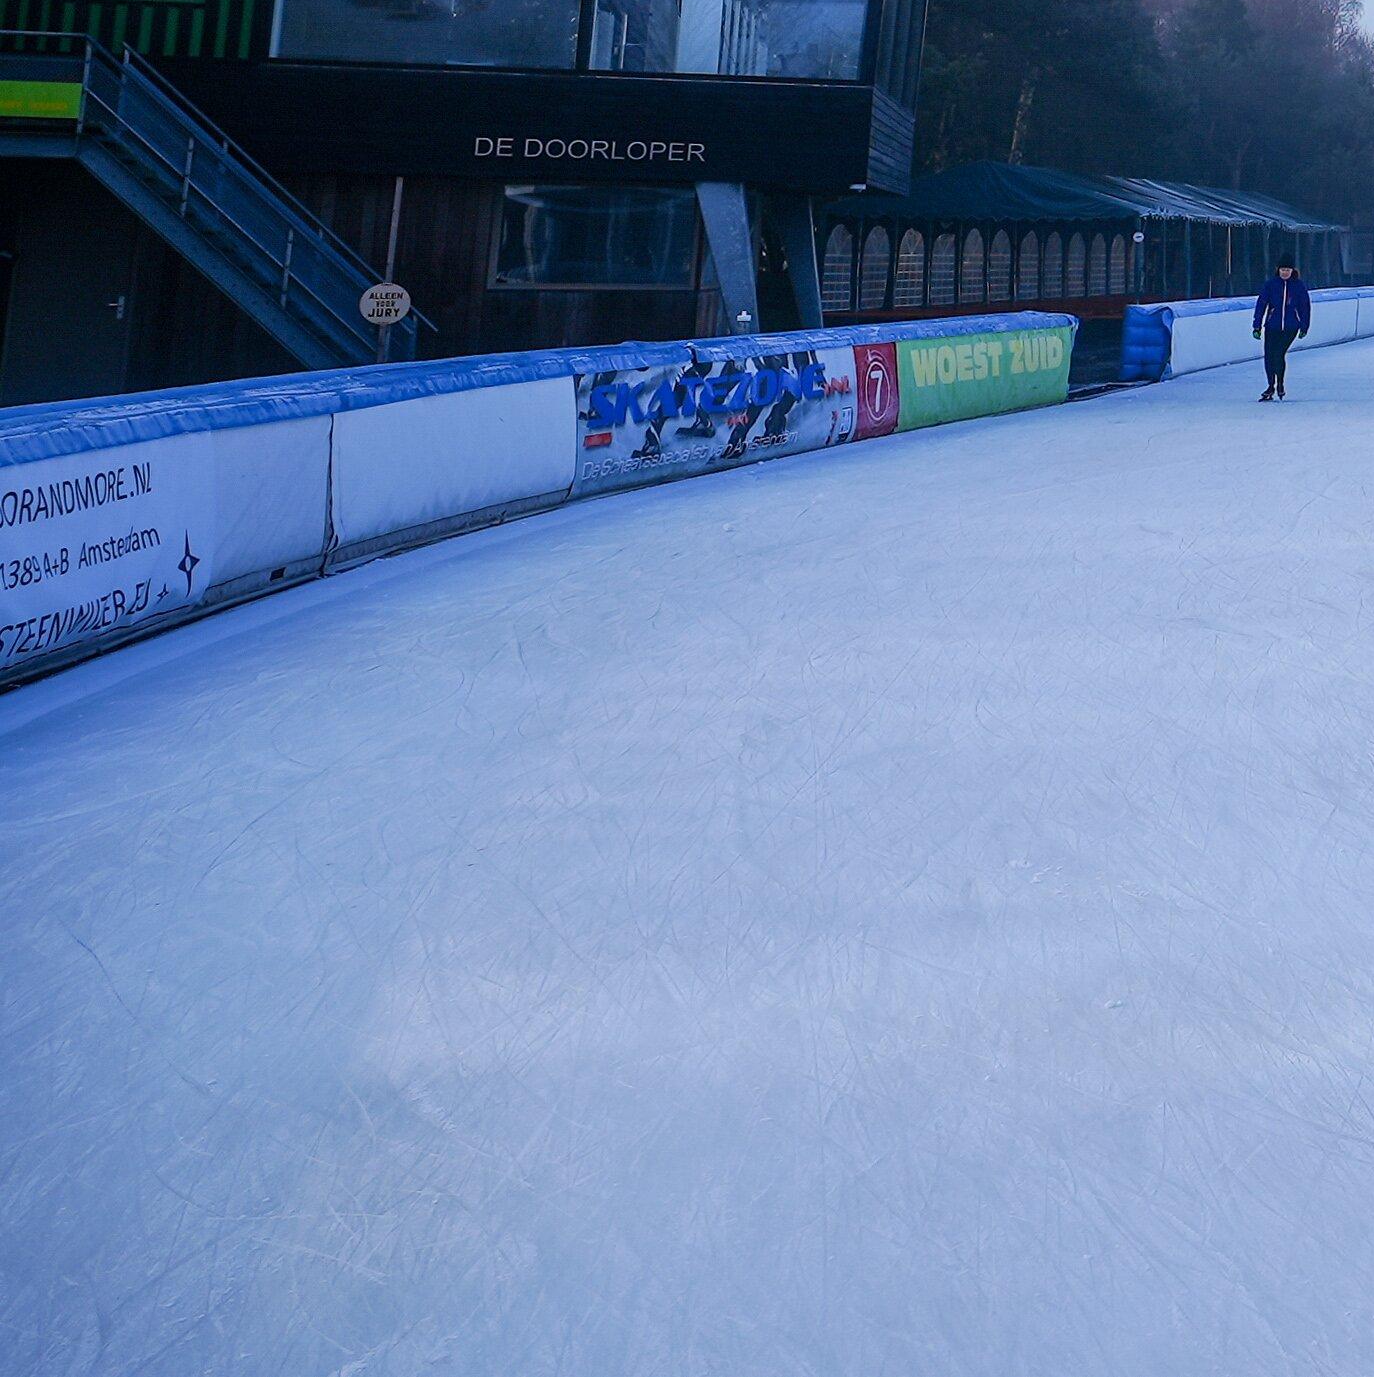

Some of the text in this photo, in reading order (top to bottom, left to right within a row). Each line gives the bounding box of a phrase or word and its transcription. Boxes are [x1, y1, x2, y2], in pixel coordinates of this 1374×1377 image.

[474, 137, 706, 162] DE DOORLOPER
[368, 308, 400, 318] JURY
[369, 292, 403, 300] ALLEEN
[910, 335, 1064, 387] WOEST ZUID
[870, 370, 884, 413] 7
[0, 462, 152, 529] ORANDMORE.NL
[78, 526, 161, 570] Amstedam
